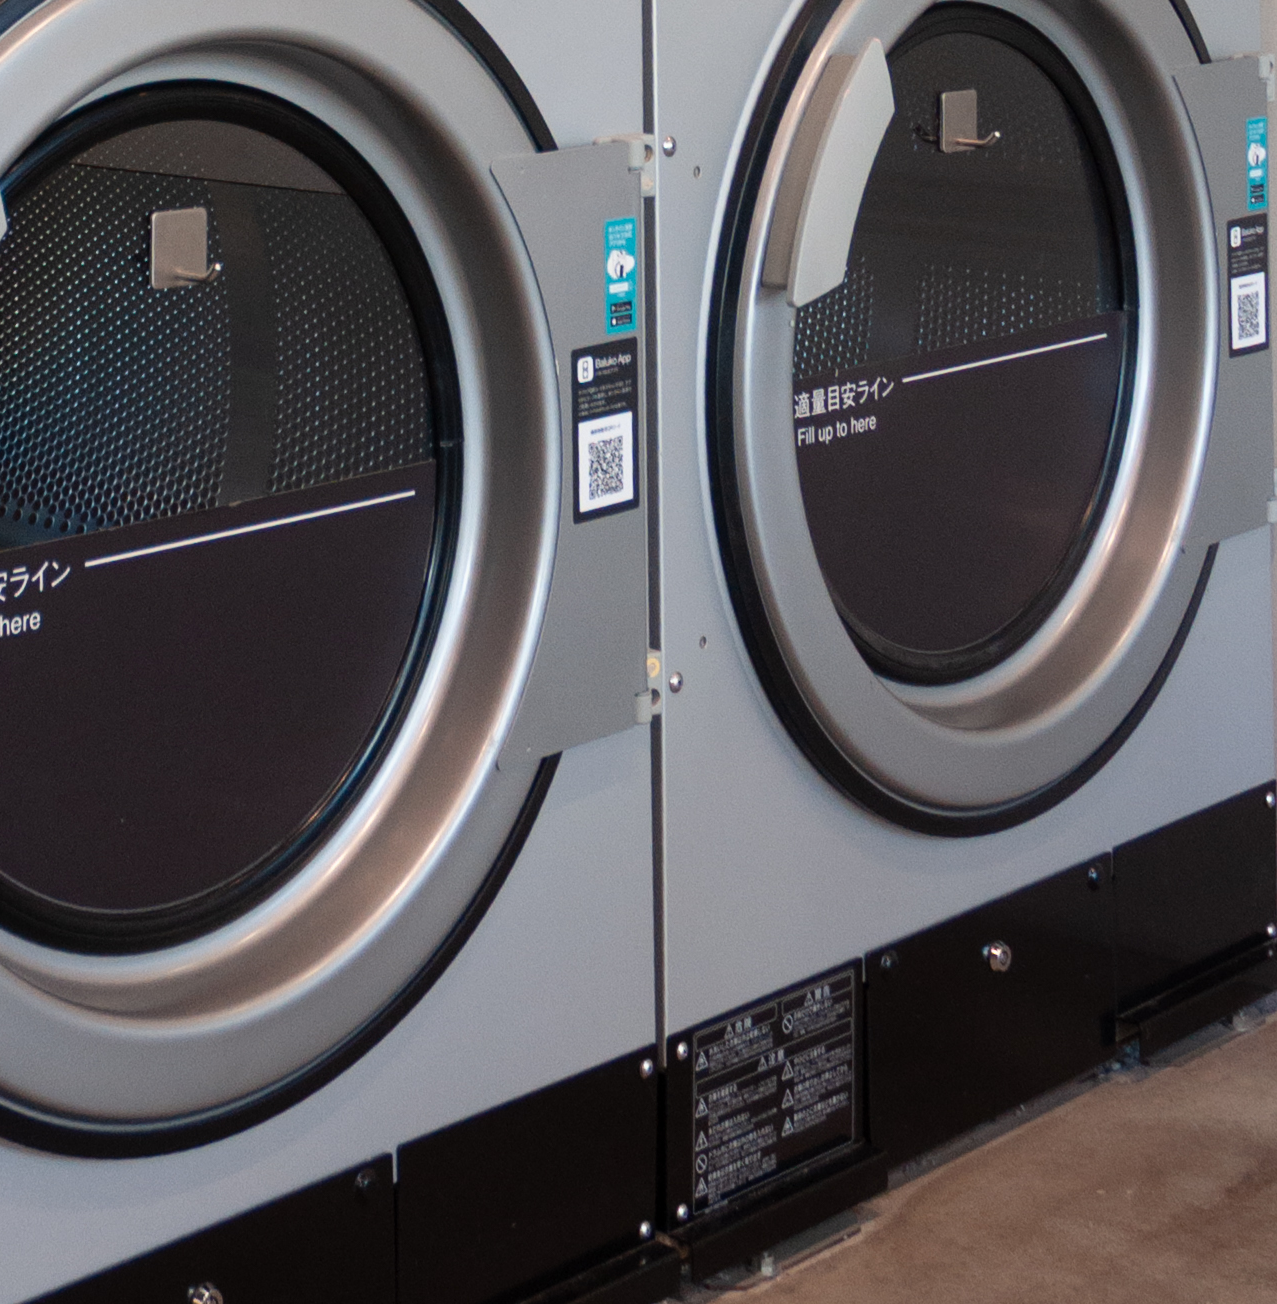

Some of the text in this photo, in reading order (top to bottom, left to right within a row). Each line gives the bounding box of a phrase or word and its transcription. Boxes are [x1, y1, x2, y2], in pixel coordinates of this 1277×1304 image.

[618, 353, 631, 366] App
[794, 376, 894, 418] 適量目安ライン
[797, 415, 876, 446] Fill up to here
[0, 611, 41, 638] here
